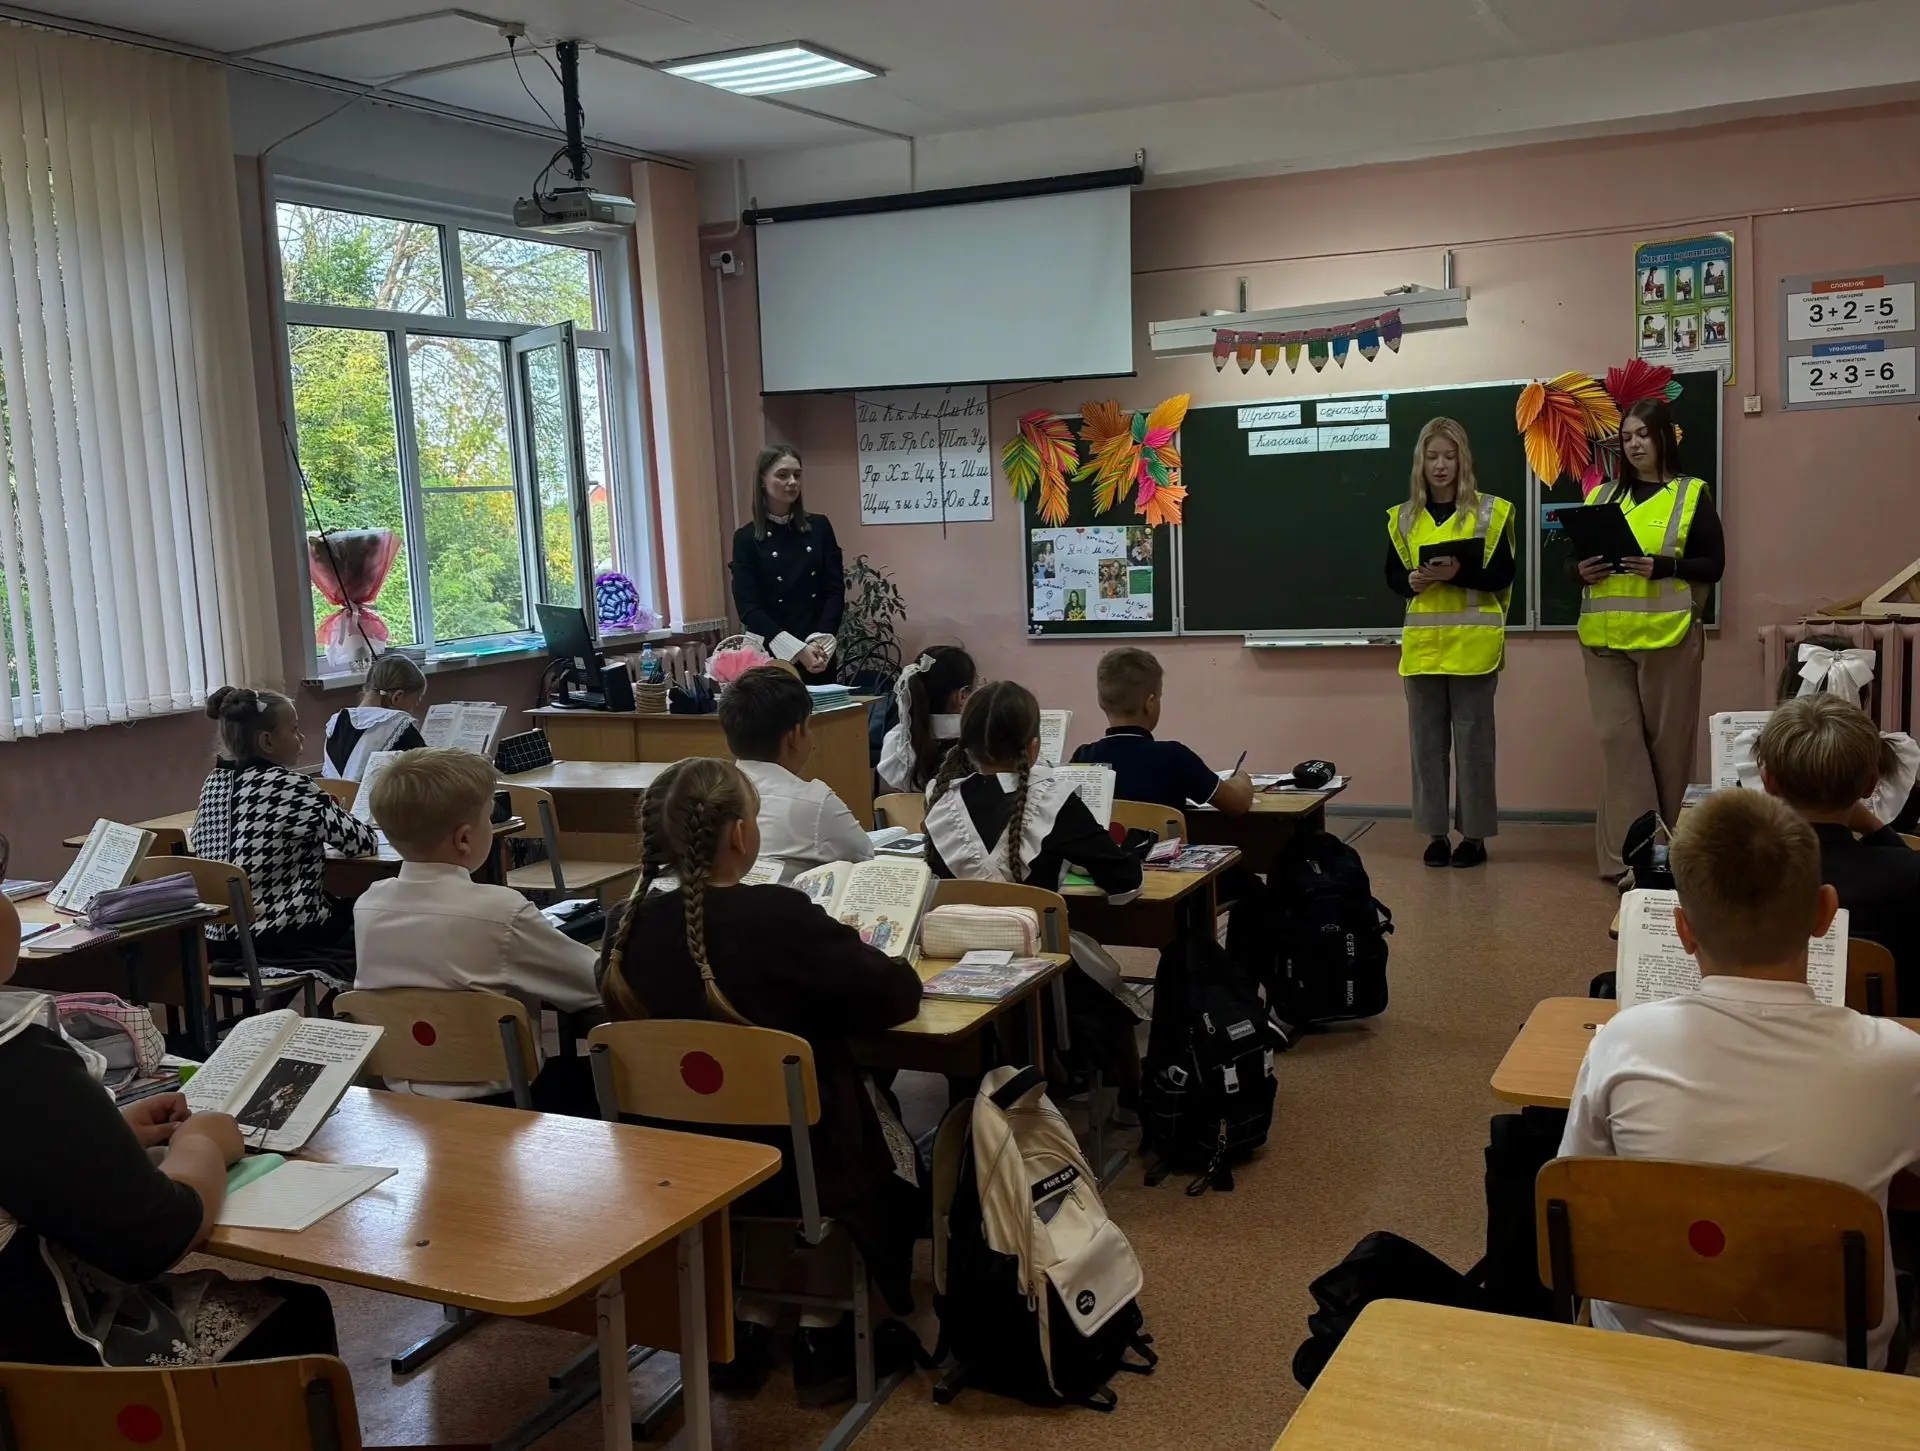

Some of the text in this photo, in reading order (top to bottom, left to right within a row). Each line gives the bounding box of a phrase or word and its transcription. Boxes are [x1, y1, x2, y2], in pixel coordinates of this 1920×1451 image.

[1830, 280, 1865, 289] СЛОЖЕНИЕ
[1256, 427, 1378, 448] Классная работа
[1346, 933, 1355, 957] C'EST
[1043, 1168, 1074, 1190] PINK CAT
